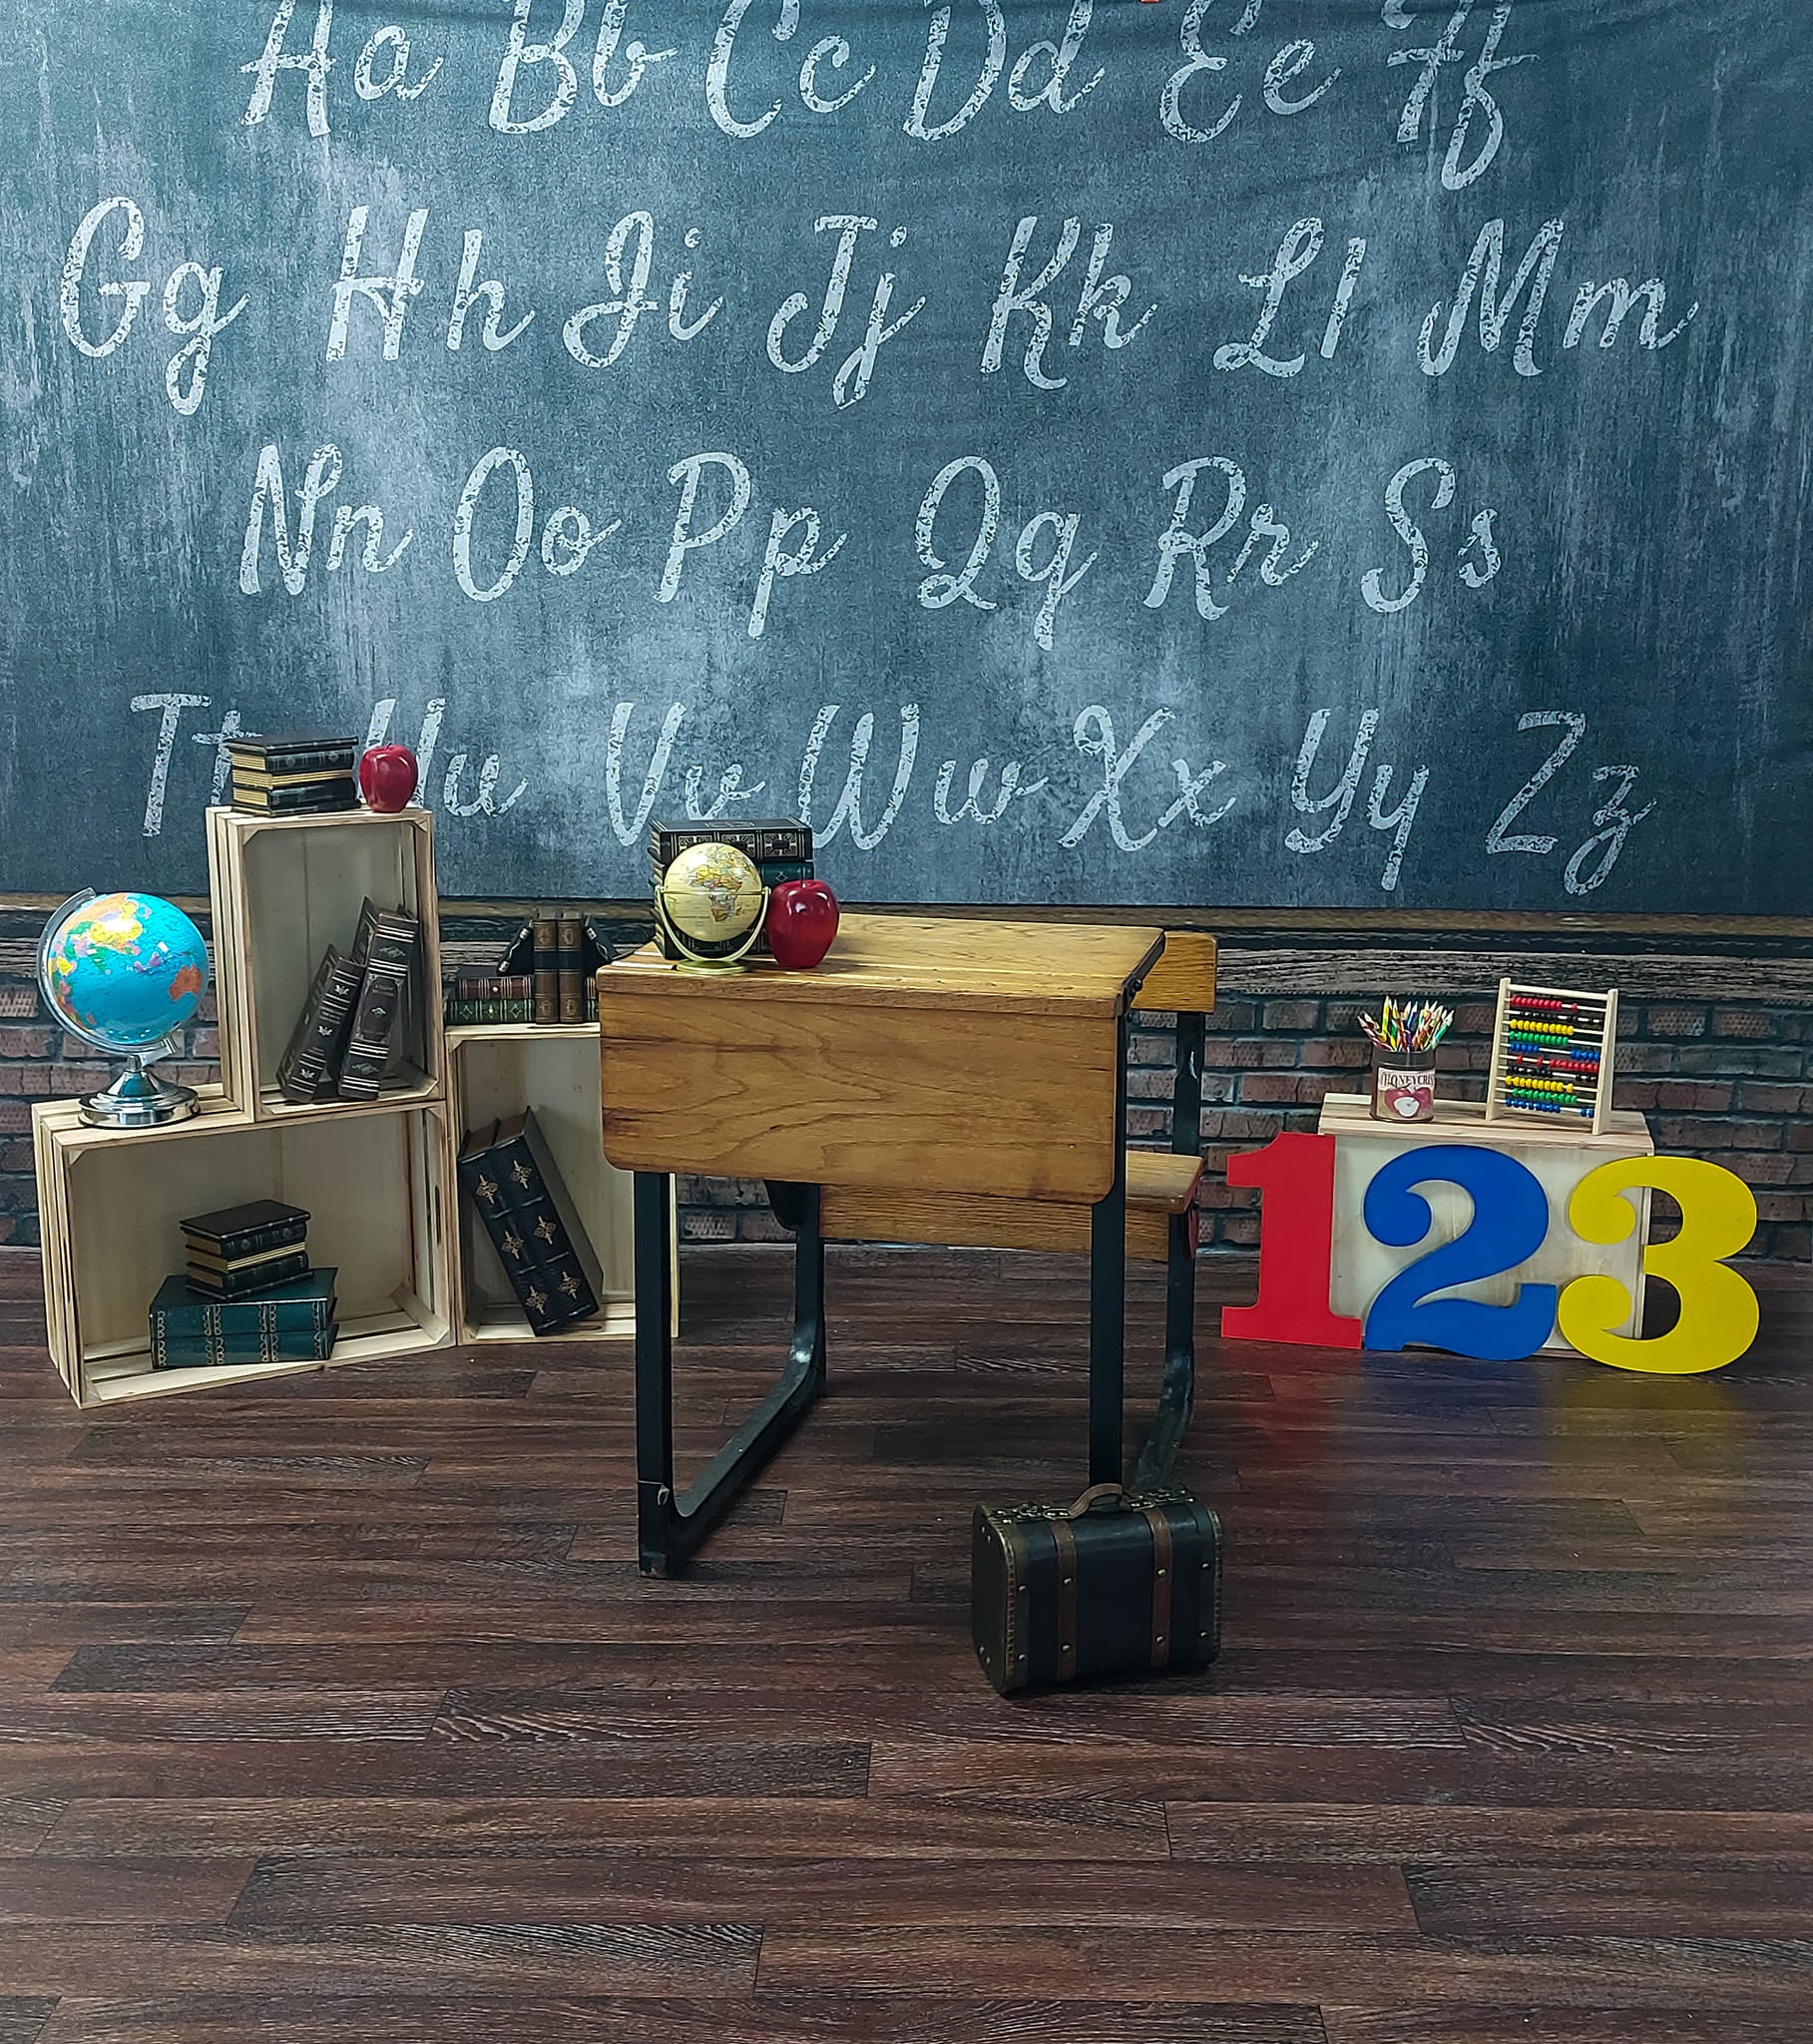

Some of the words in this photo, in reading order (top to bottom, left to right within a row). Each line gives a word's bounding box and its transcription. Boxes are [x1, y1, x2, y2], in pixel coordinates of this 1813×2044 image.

[705, 0, 877, 138] Cc
[1158, 0, 1341, 144] Ee
[60, 196, 250, 416] Gg
[326, 204, 537, 362] Hh
[765, 214, 924, 408] Jj
[980, 216, 1158, 390] Kk
[1212, 217, 1366, 379] Ll
[1417, 217, 1699, 377] Mm
[238, 442, 414, 597] Nn
[452, 445, 623, 602] Oo
[653, 451, 849, 639] Pp
[916, 455, 1099, 650] Qq
[1142, 456, 1319, 621] Rr
[1361, 457, 1502, 613] Ss
[608, 702, 765, 846] Vv
[798, 704, 1049, 850] Ww
[1057, 704, 1237, 852] Xx
[1284, 707, 1430, 889] Yy
[1486, 711, 1658, 895] Zz
